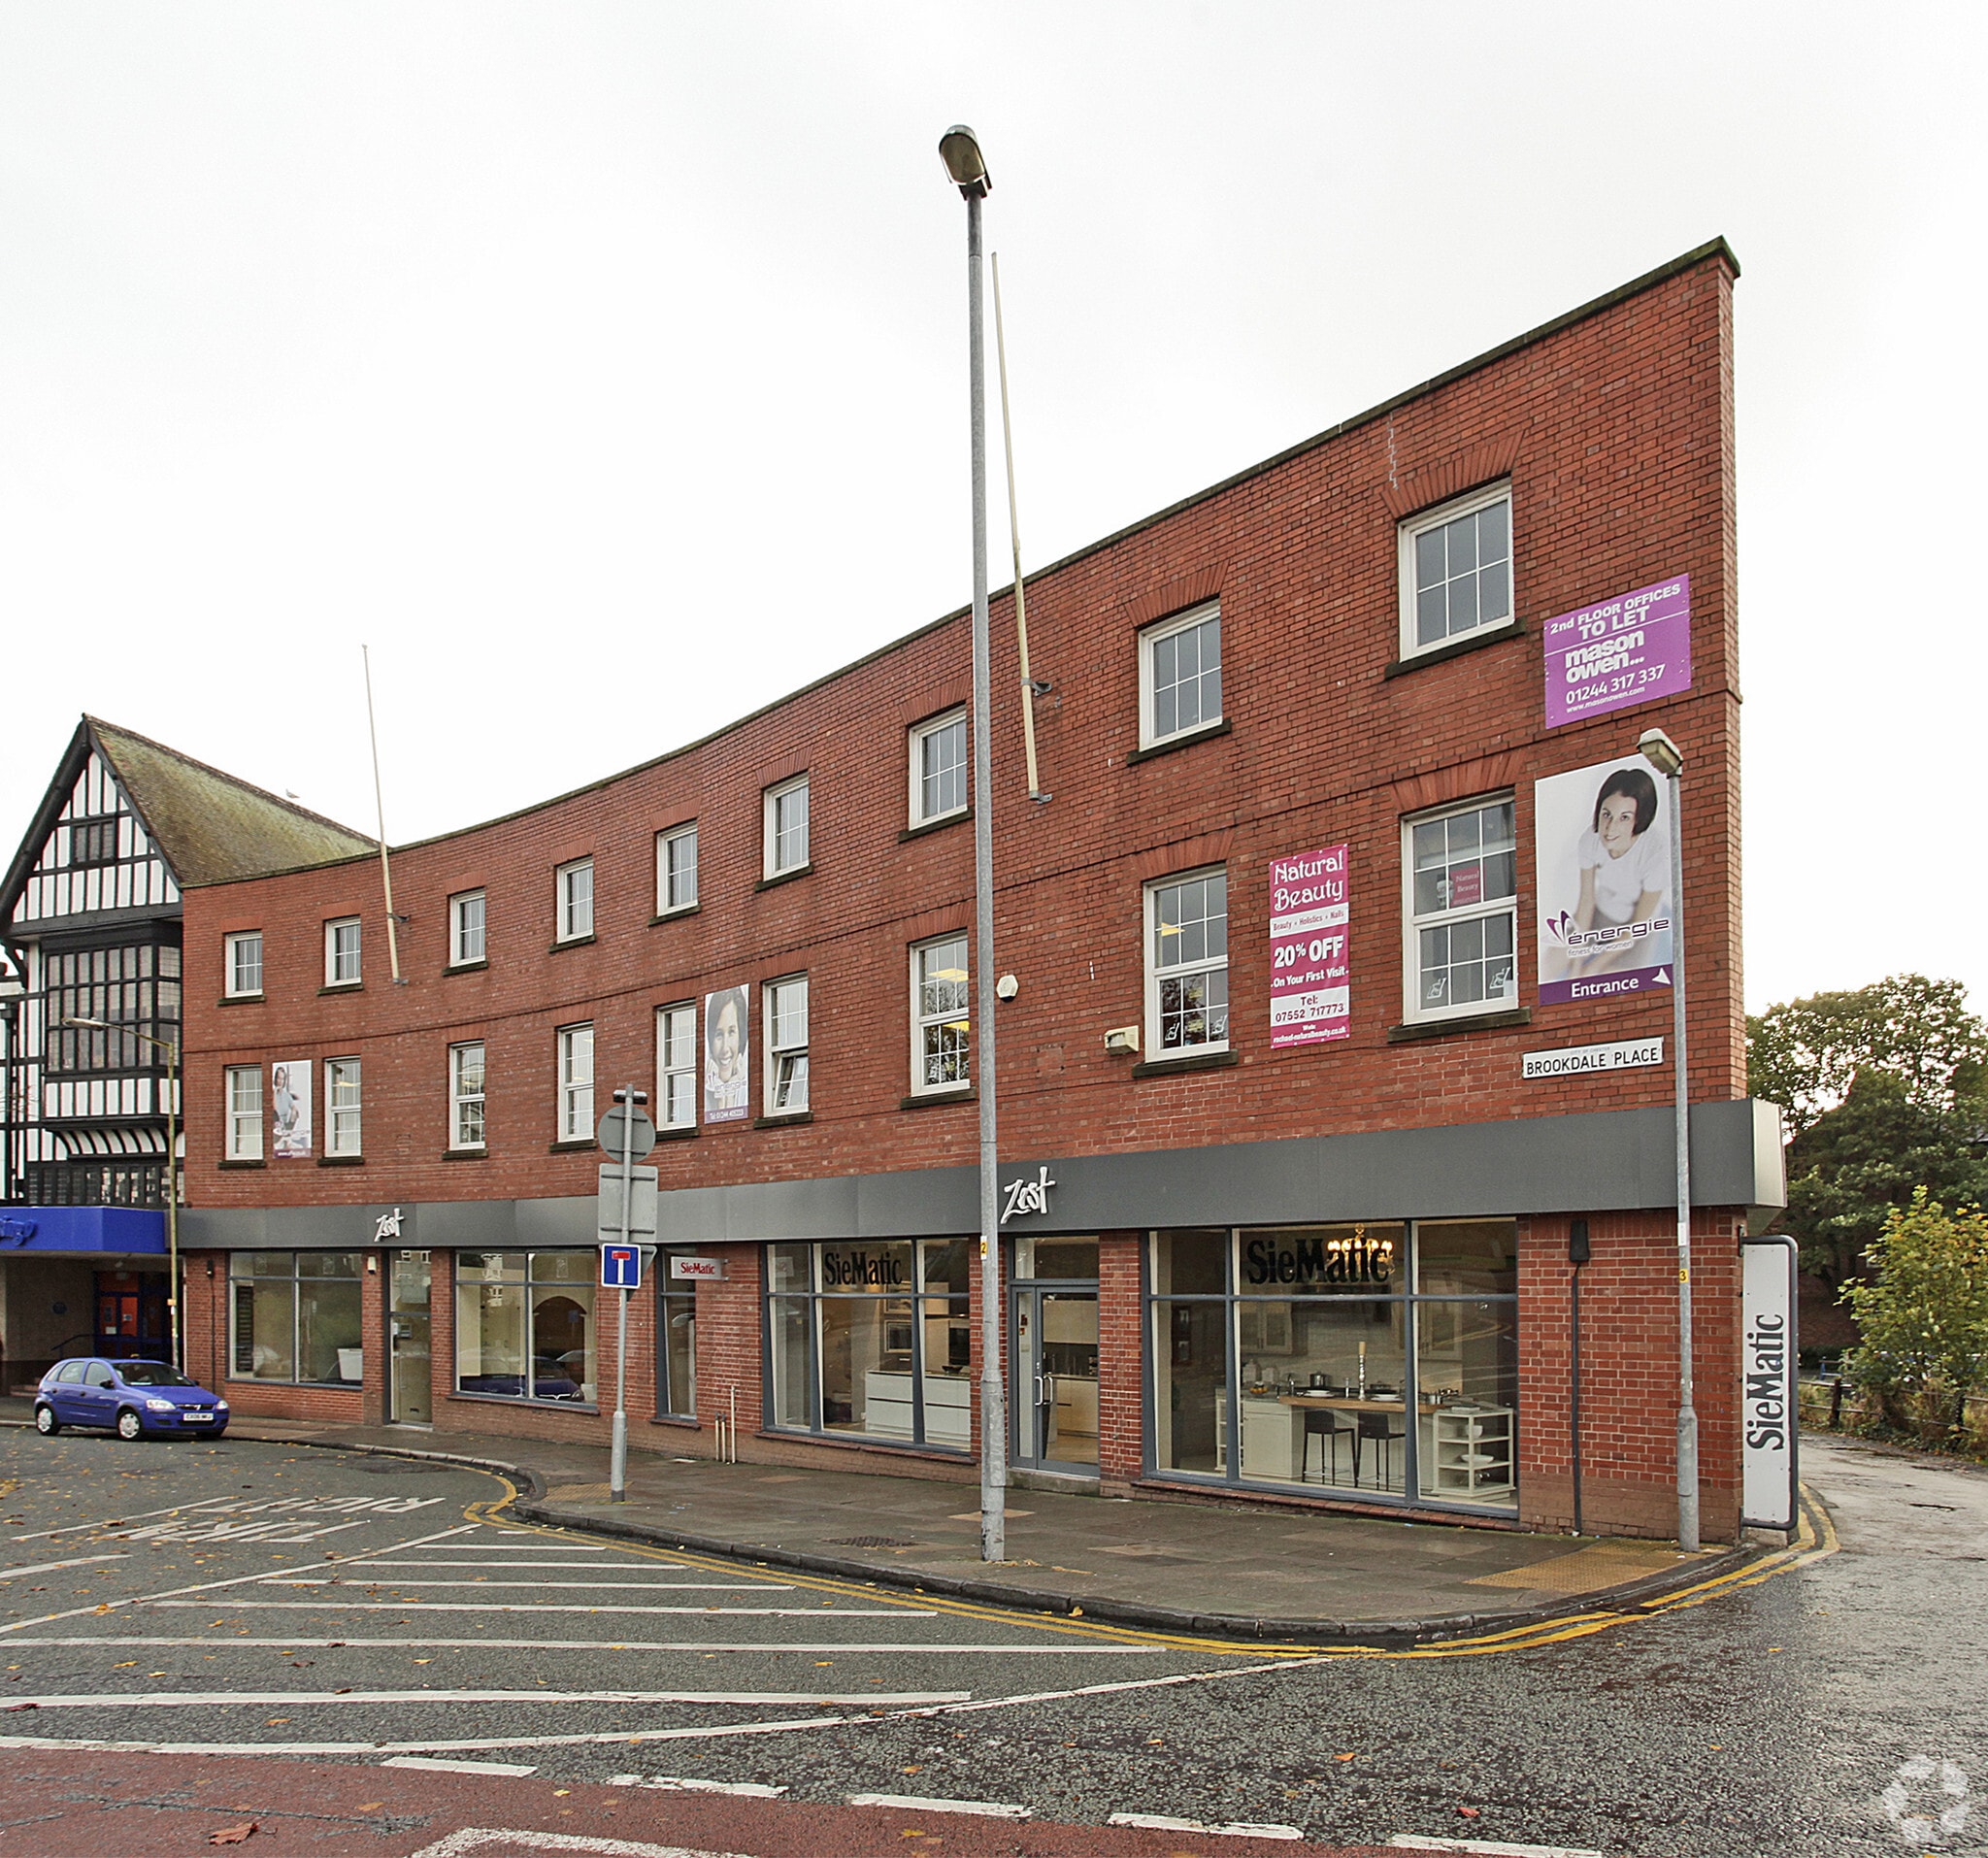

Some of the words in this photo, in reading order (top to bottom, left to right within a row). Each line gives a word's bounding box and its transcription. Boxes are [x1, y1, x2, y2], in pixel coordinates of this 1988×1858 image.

[1550, 617, 1574, 635] 2nd
[1577, 603, 1621, 625] FLOOR
[1624, 583, 1681, 610] OFFICES
[1578, 620, 1606, 640] TO
[1611, 605, 1650, 631] LET
[1565, 630, 1644, 668] mason
[1566, 680, 1607, 705] 01244
[1610, 673, 1636, 692] 317
[1639, 663, 1666, 684] 337
[1566, 686, 1645, 713] www.masonowen.com
[1274, 849, 1343, 885] Natural
[1274, 879, 1343, 912] Beauty
[1274, 943, 1307, 968] 20%
[1309, 935, 1344, 962] OFF
[1568, 947, 1591, 956] fitness
[1592, 945, 1604, 953] for
[1606, 941, 1633, 951] women
[1273, 977, 1285, 988] On
[1285, 974, 1305, 986] Your
[1306, 970, 1325, 981] First
[1326, 966, 1345, 979] Visit
[1571, 978, 1640, 998] Entrance
[1275, 1009, 1306, 1022] 07552
[1309, 1003, 1344, 1017] 717773
[1300, 995, 1318, 1006] Tel:
[1527, 1053, 1607, 1075] BROOKDALE
[1614, 1047, 1659, 1066] PLACE
[1000, 1166, 1055, 1224] Zest
[374, 1208, 404, 1243] Zest
[980, 1243, 986, 1254] 2
[1246, 1236, 1390, 1284] SieMatic
[679, 1261, 715, 1275] SieMatic
[824, 1251, 903, 1285] SieMatic
[1679, 1271, 1687, 1281] 3
[1745, 1313, 1784, 1451] SieMatic
